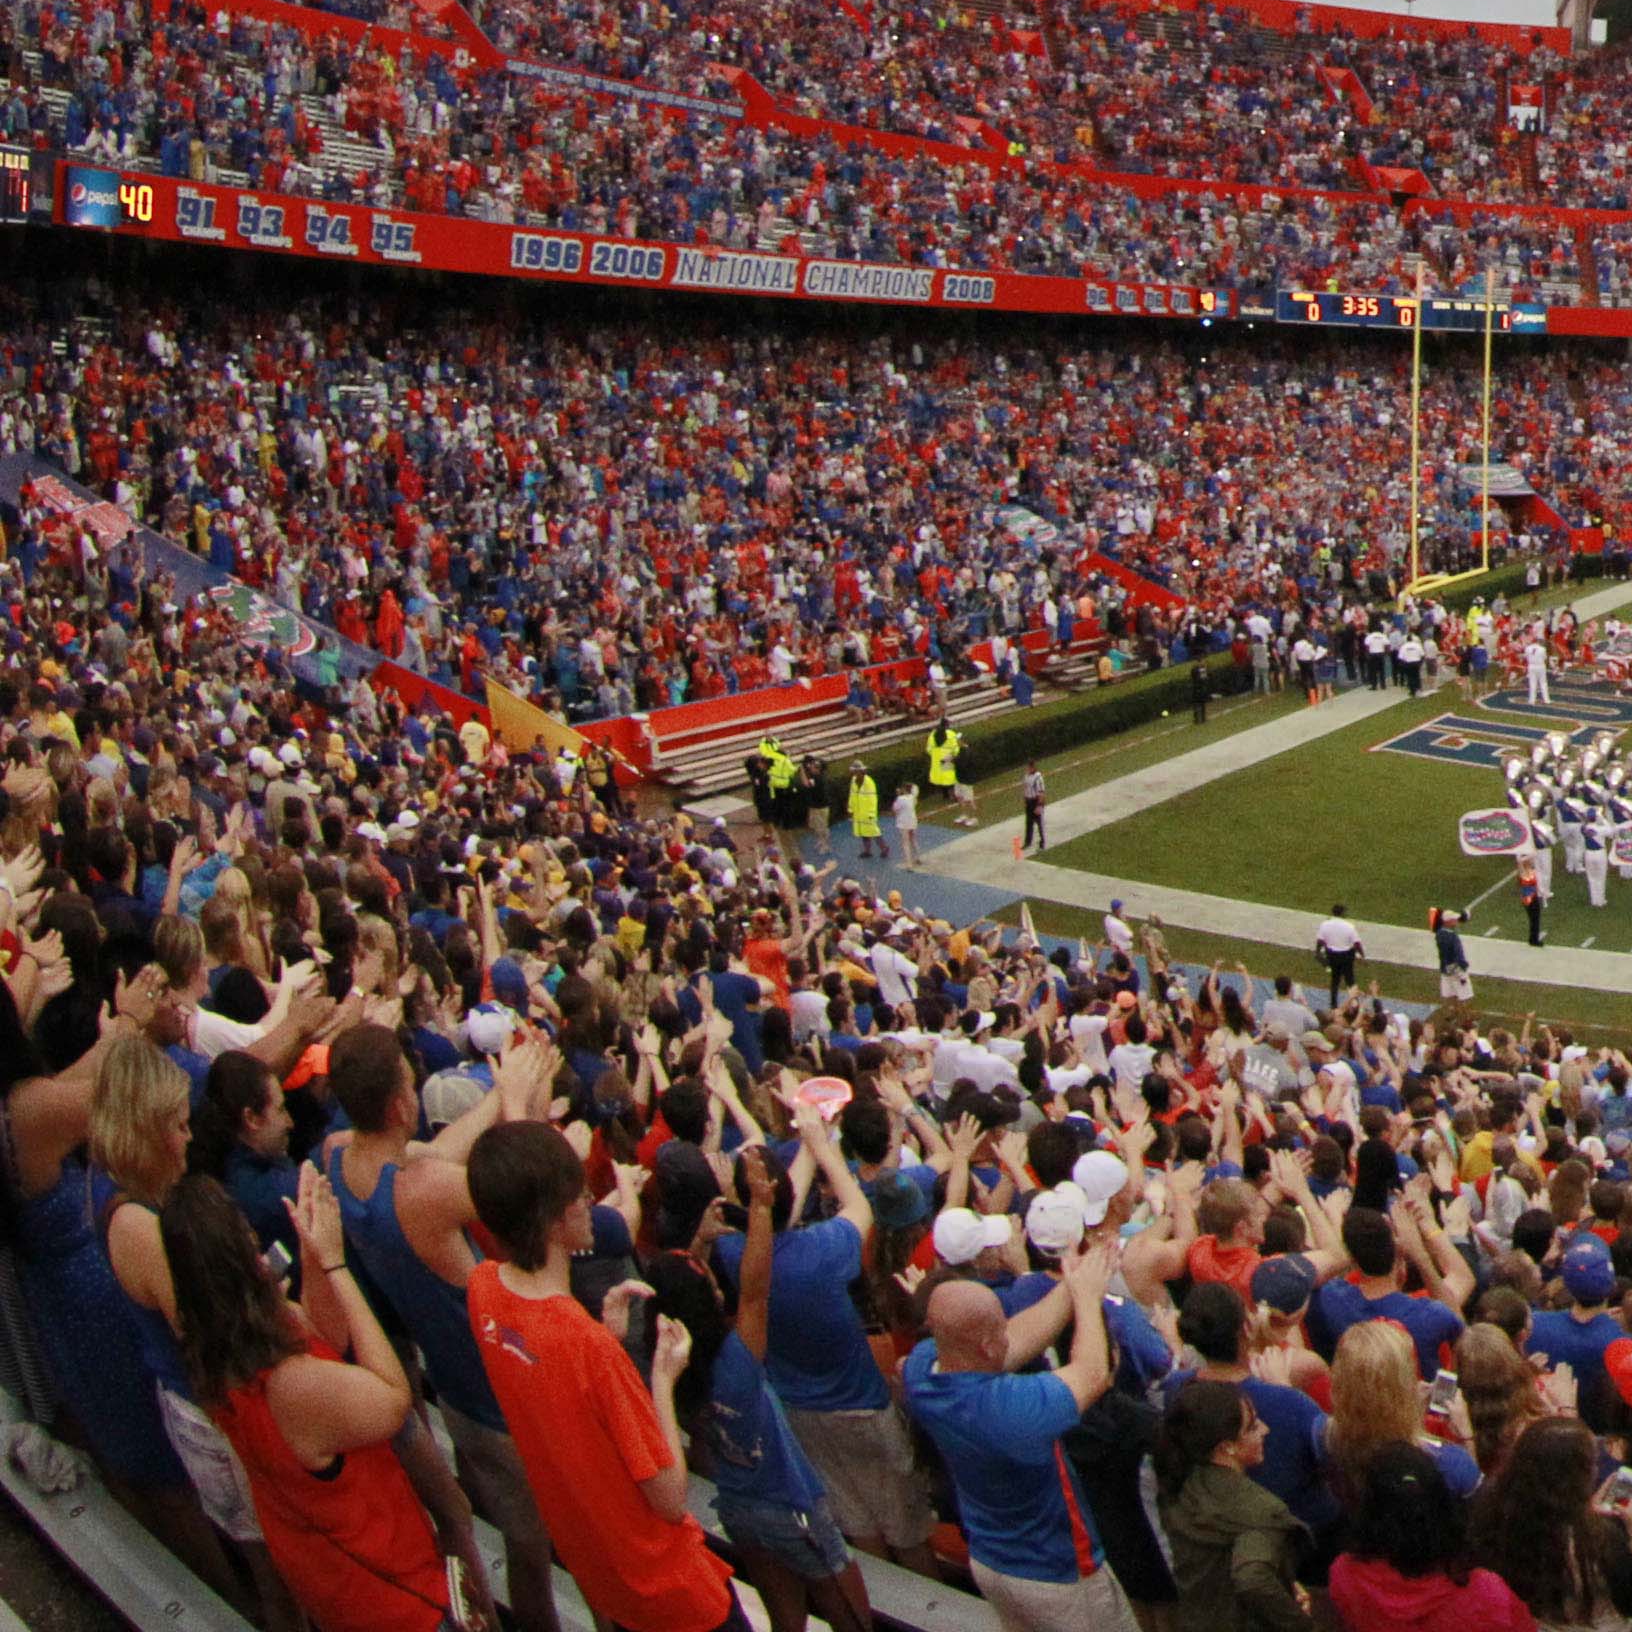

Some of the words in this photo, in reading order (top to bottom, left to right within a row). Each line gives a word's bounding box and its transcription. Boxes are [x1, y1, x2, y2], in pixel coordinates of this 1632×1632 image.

[119, 184, 153, 221] 40
[177, 197, 216, 228] 91
[238, 205, 284, 236] 93
[306, 214, 350, 244] 94
[373, 223, 415, 252] 95
[511, 234, 582, 272] 1996
[590, 241, 665, 279] 2006
[675, 249, 798, 292] NATIONAL
[804, 260, 933, 300] CHAMPIONS
[942, 274, 995, 303] 2008
[1308, 303, 1320, 321] 0
[1343, 296, 1379, 316] 3:35
[1400, 308, 1412, 326] 0
